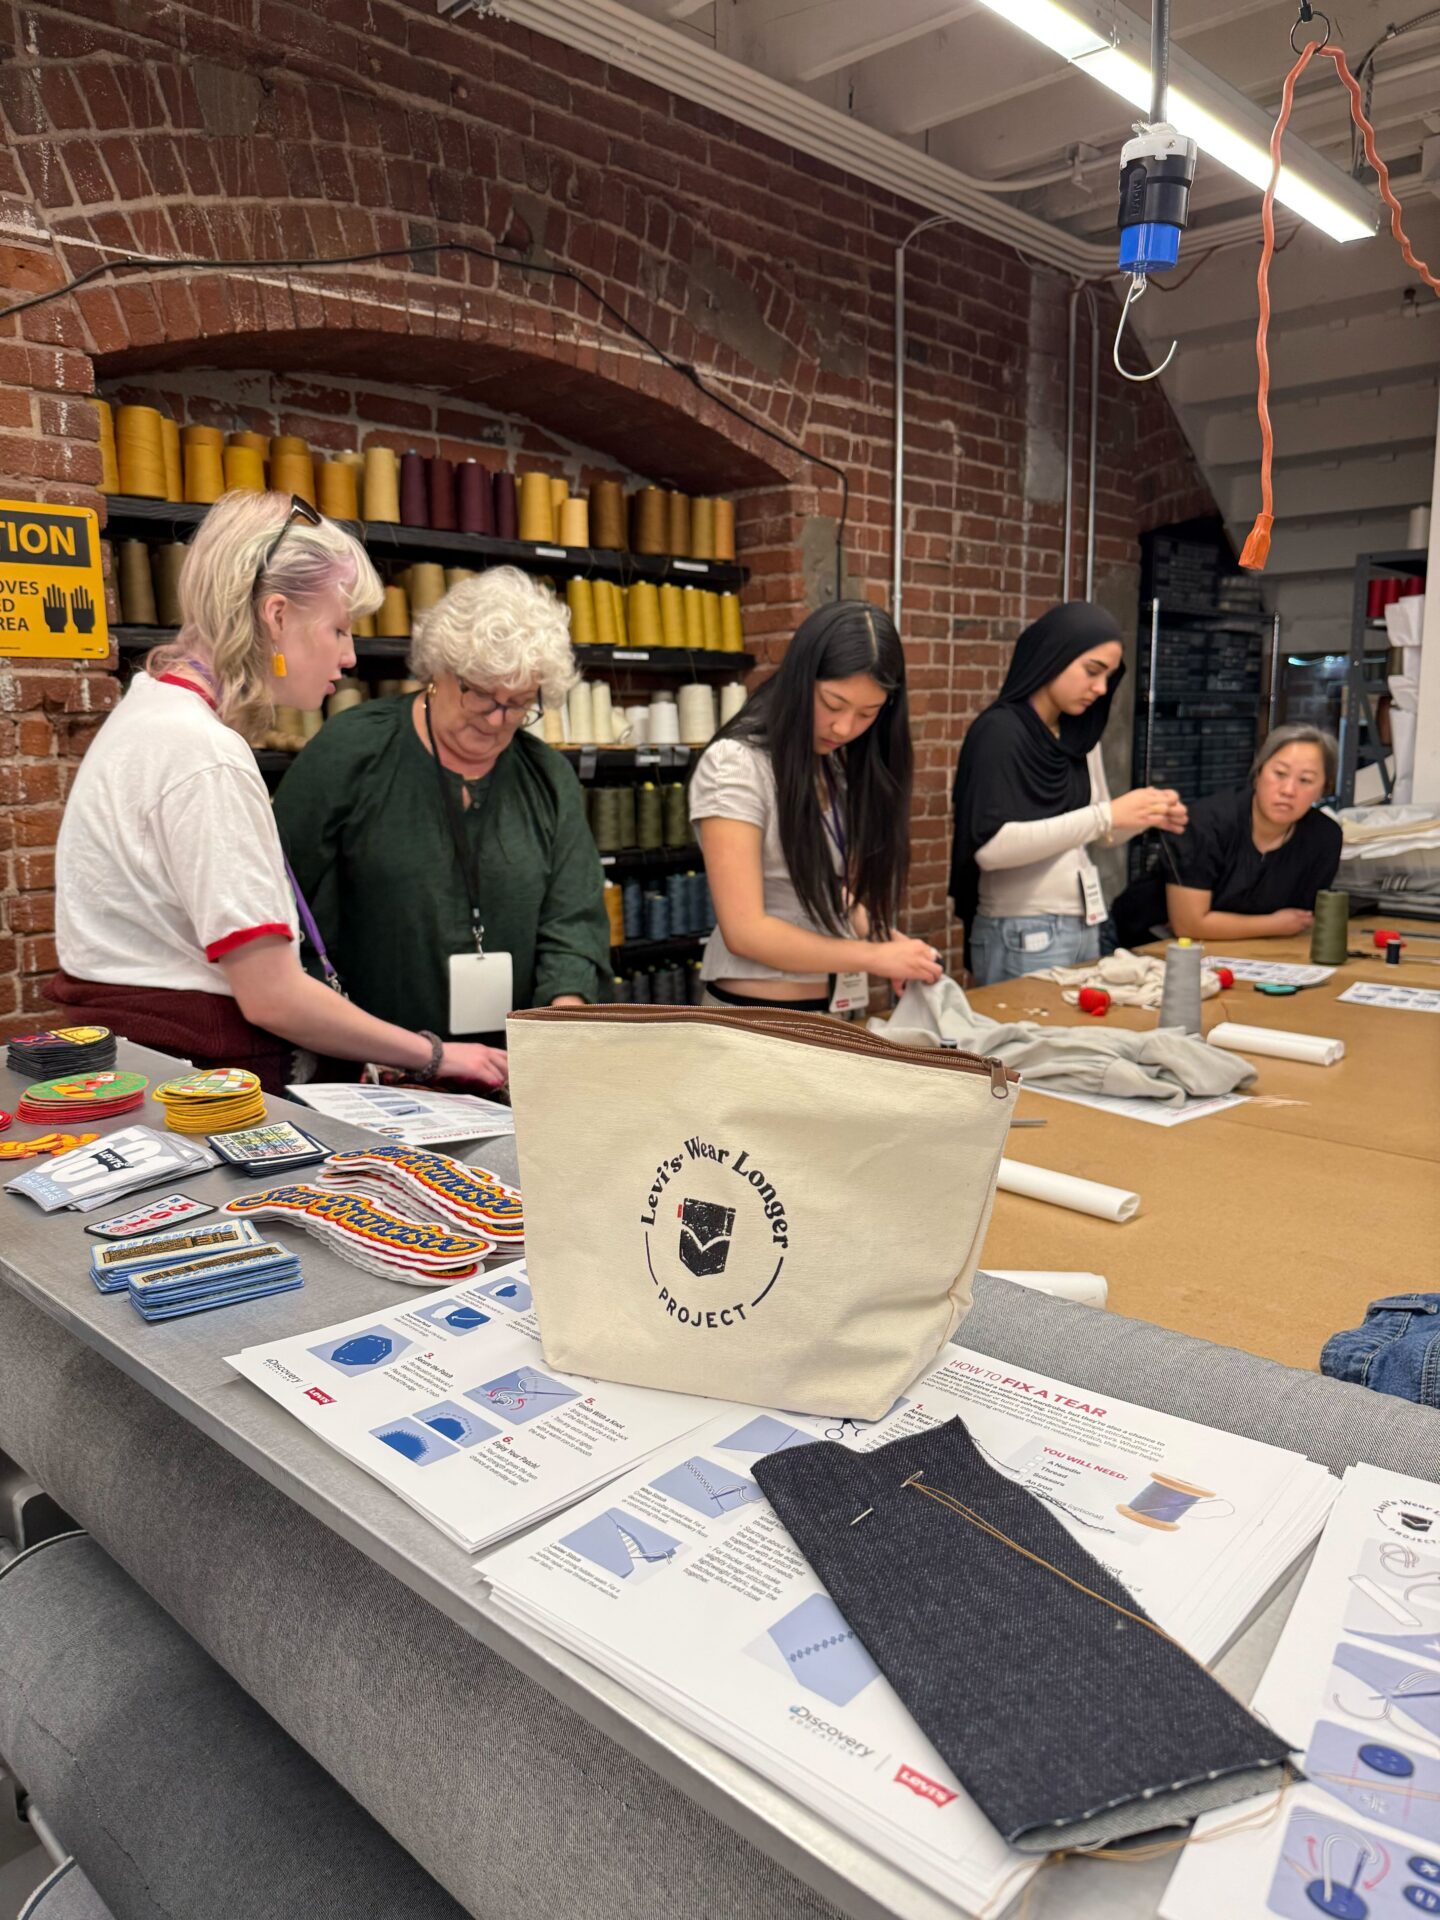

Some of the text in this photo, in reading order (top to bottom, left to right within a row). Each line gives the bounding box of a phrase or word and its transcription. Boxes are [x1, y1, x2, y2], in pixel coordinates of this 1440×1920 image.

[640, 1135, 789, 1249] Levi's Wear Longer
[238, 1186, 480, 1252] San Francisco
[658, 1286, 747, 1328] PROJECT
[584, 1397, 595, 1405] 5.
[950, 1360, 983, 1374] HOW
[983, 1371, 1002, 1380] TO
[1001, 1378, 1034, 1391] FIX
[1055, 1395, 1107, 1416] TEAR
[502, 1436, 514, 1444] 6.
[609, 1420, 625, 1428] Knot
[492, 1441, 508, 1451] Enjoy
[507, 1450, 521, 1458] Your
[1043, 1447, 1127, 1480] YOU WILL NEED:
[1041, 1466, 1068, 1478] Thread
[790, 1706, 874, 1756] Discovery
